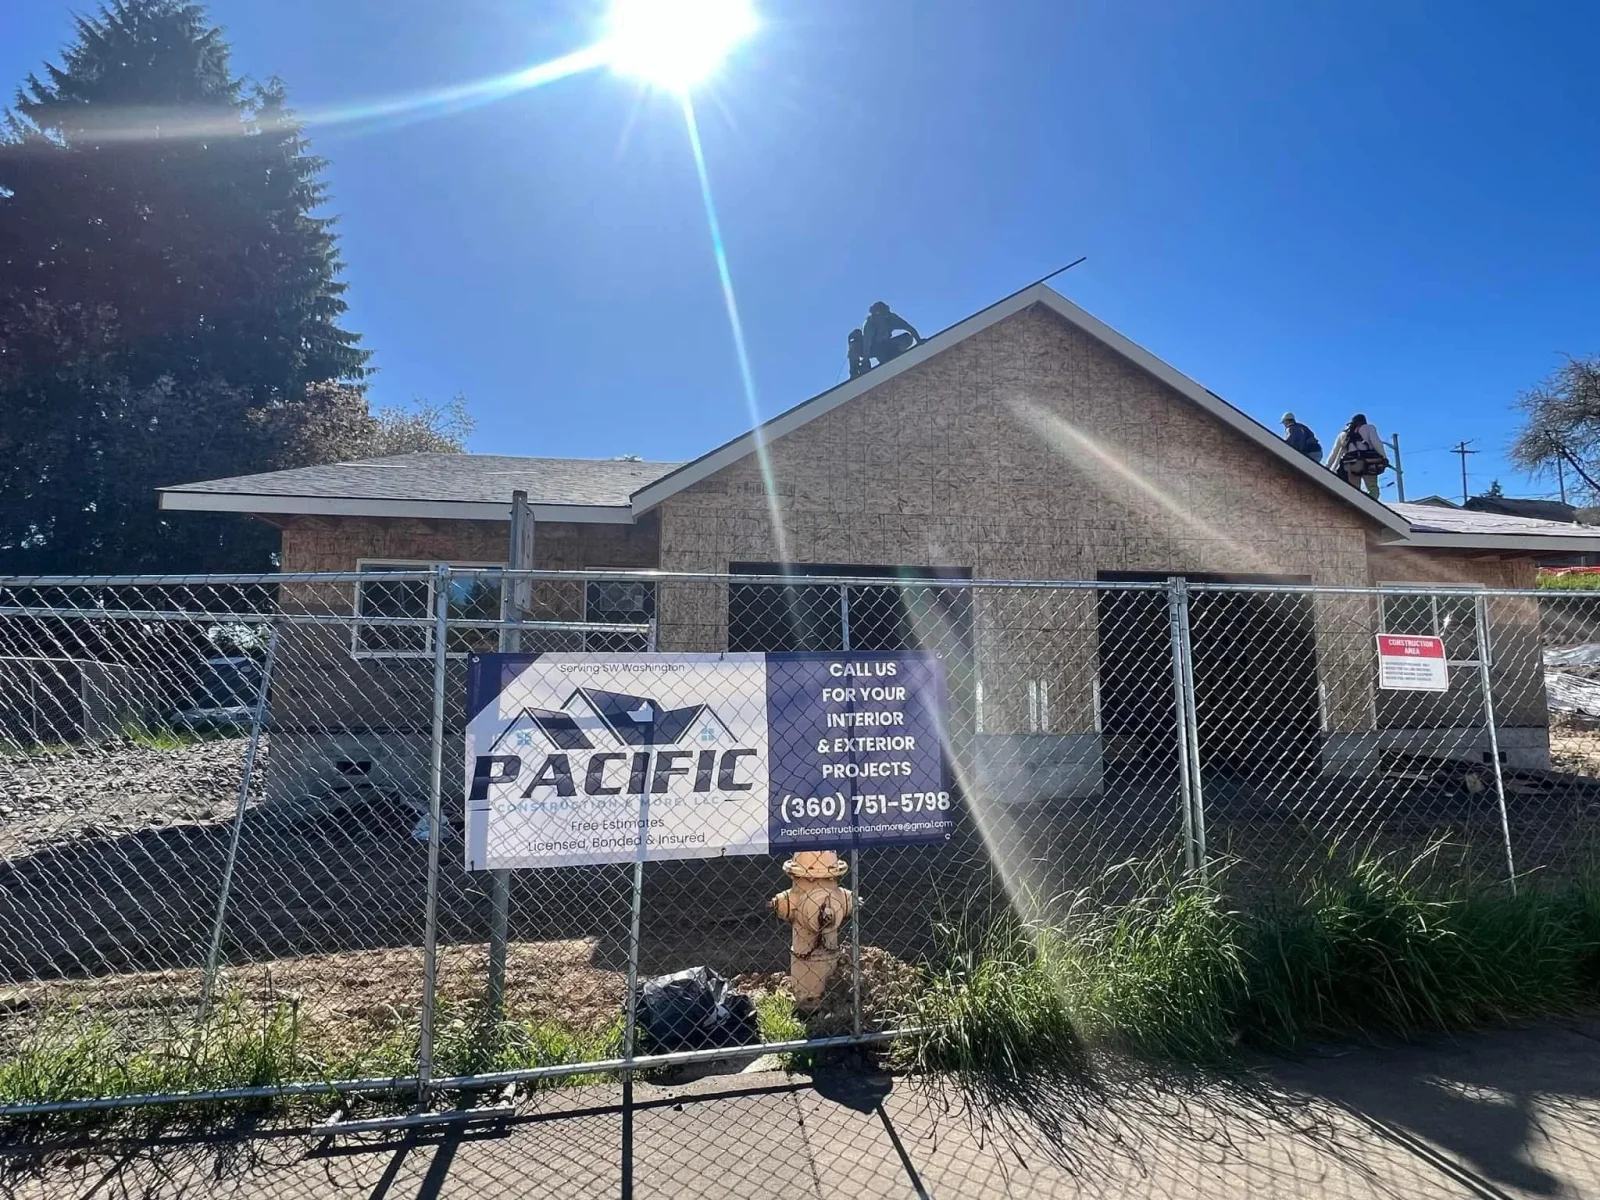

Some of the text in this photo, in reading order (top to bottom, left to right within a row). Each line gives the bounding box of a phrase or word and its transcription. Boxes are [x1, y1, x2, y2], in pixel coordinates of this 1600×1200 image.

[560, 663, 685, 674] Serving SW Washington
[829, 662, 897, 677] CALL US
[822, 687, 906, 702] FOR YOUR
[827, 711, 904, 728] INTERIOR
[817, 736, 915, 753] & EXTERIOR
[468, 749, 757, 801] PACIFIC
[822, 762, 912, 779] PROJECTS
[781, 791, 950, 823] (360) 751-5798
[571, 818, 665, 831] Free Estimates
[528, 832, 705, 852] Licensed, Bonded & Insured
